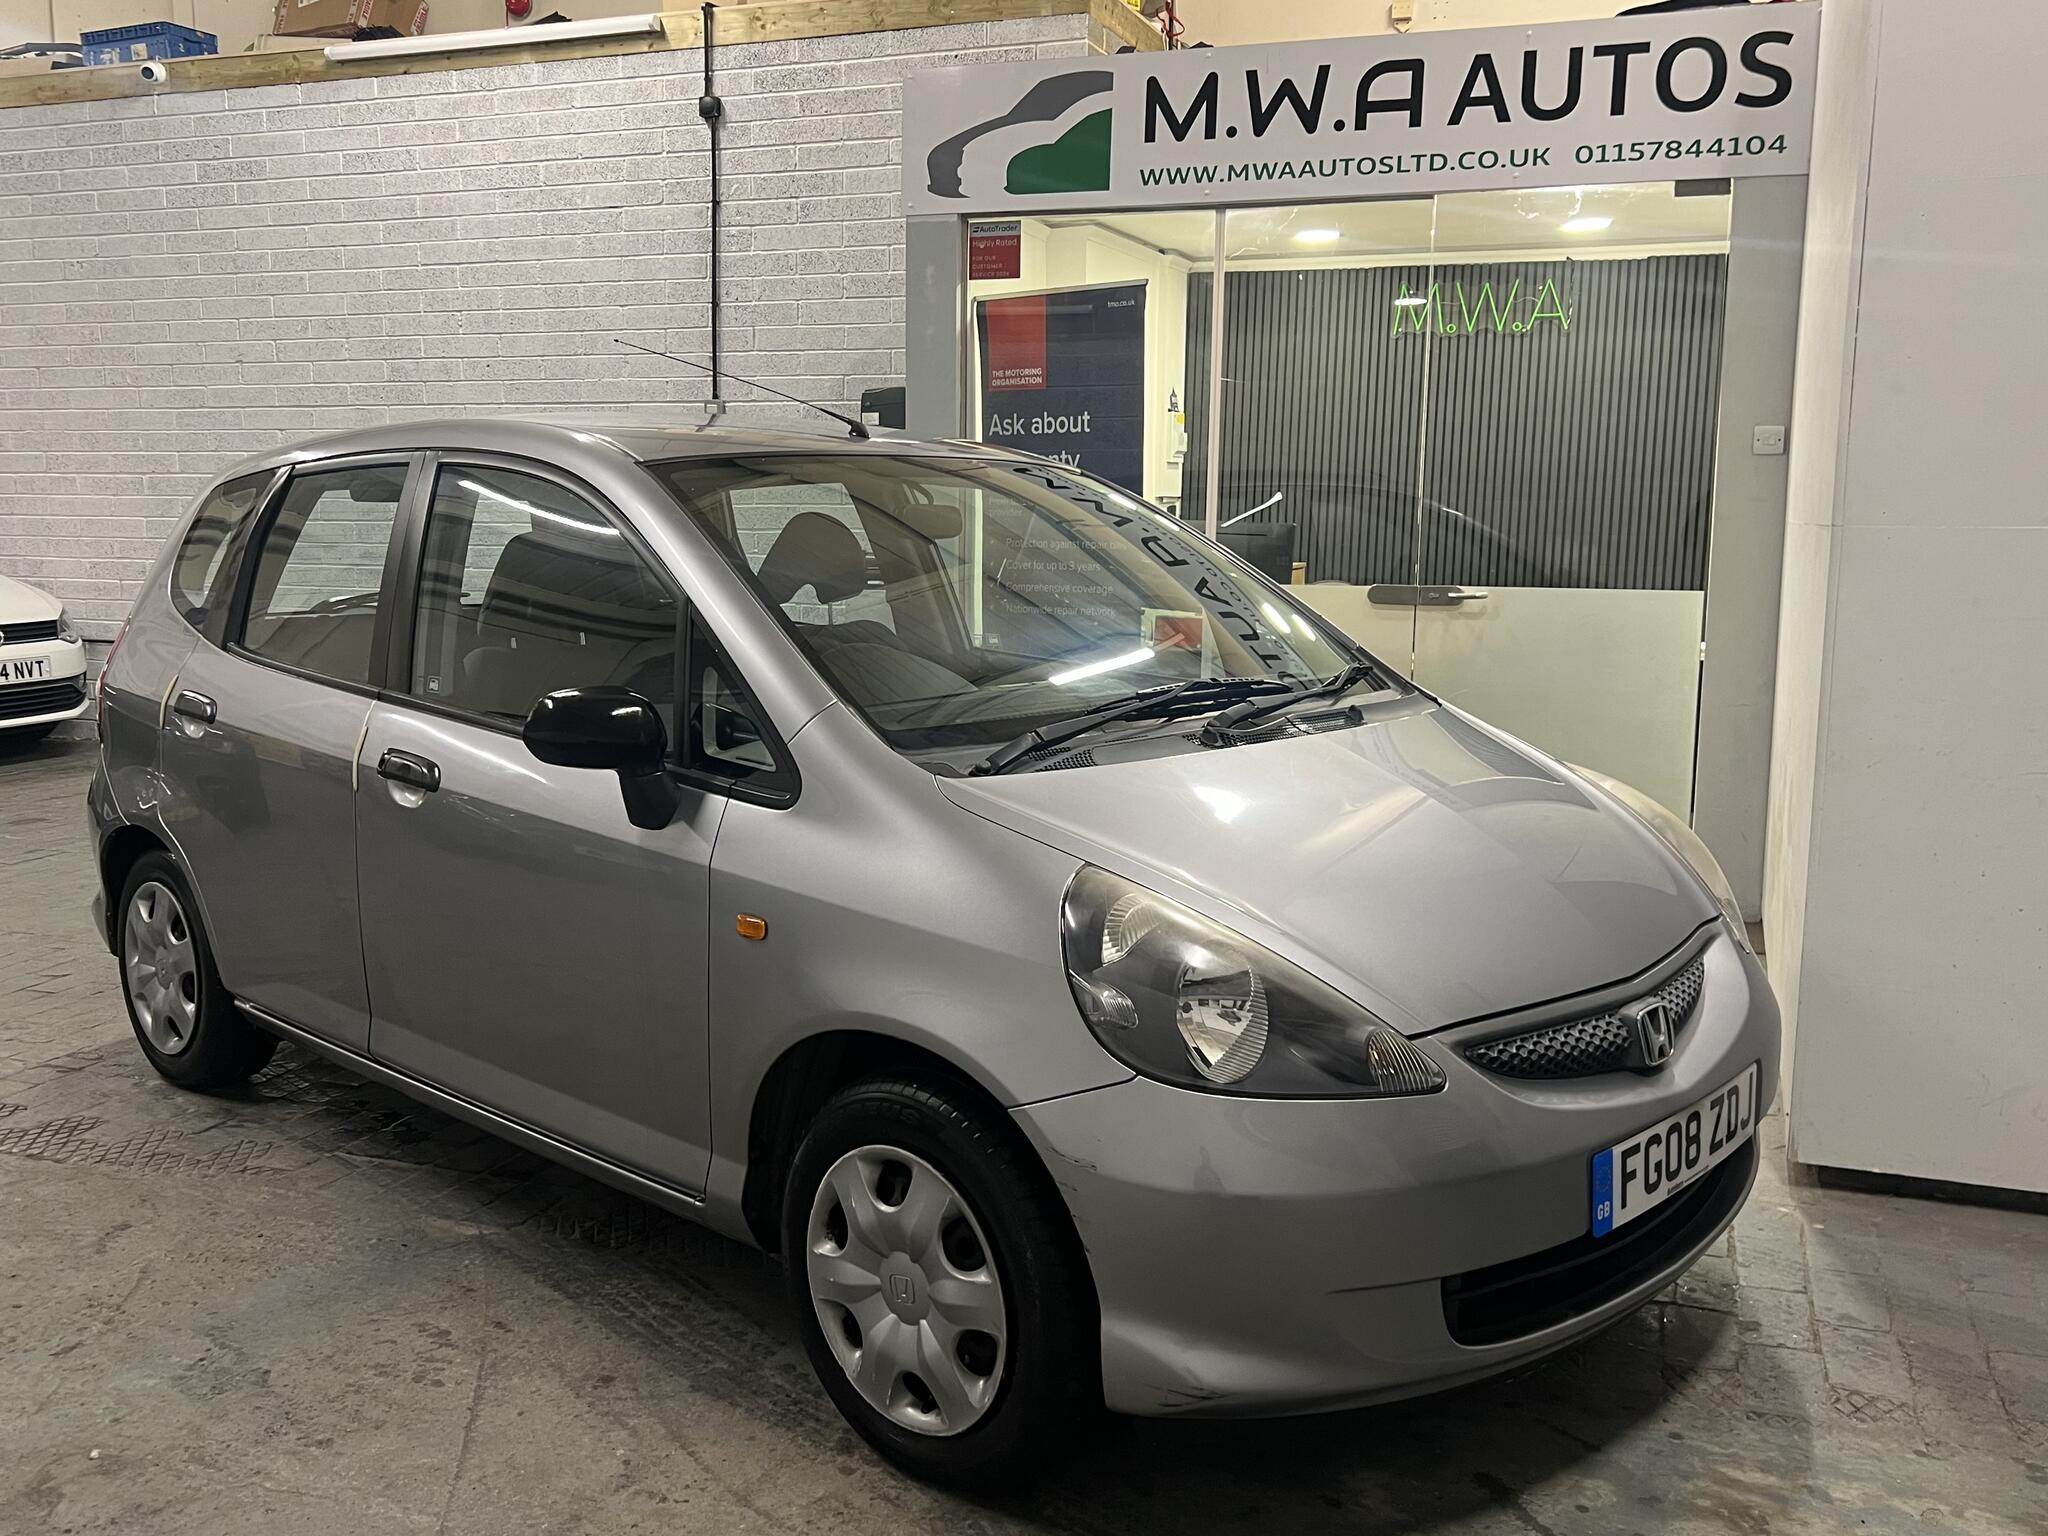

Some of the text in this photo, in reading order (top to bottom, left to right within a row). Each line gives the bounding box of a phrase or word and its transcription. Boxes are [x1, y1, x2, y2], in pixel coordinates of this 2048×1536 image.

[1144, 31, 1794, 143] M.W.A AUTOS
[1139, 134, 1787, 186] WWW.MWAAUTOSLTD.CO.UK 01157844104
[980, 224, 1018, 233] AutoTrader
[972, 238, 1018, 248] Highly Rated
[1107, 299, 1135, 308] tmo.co.uk
[1393, 278, 1568, 336] M.W.A
[992, 367, 1042, 378] THE MOTORING
[992, 376, 1042, 386] ORGANISATION
[989, 411, 1091, 437] Ask about
[1006, 537, 1048, 548] Protection
[1050, 539, 1080, 552] against
[1081, 538, 1107, 551] repair
[1006, 560, 1033, 570] Cover
[1033, 560, 1044, 570] for
[1047, 561, 1057, 573] up
[1058, 560, 1068, 570] to
[1077, 562, 1100, 573] years
[1005, 581, 1113, 595] Comprehensive coverage
[1006, 603, 1116, 617] Nationwide repair network
[14, 660, 44, 679] NVT
[1621, 1072, 1753, 1210] FG08 ZDJ
[1597, 1201, 1610, 1220] GB
